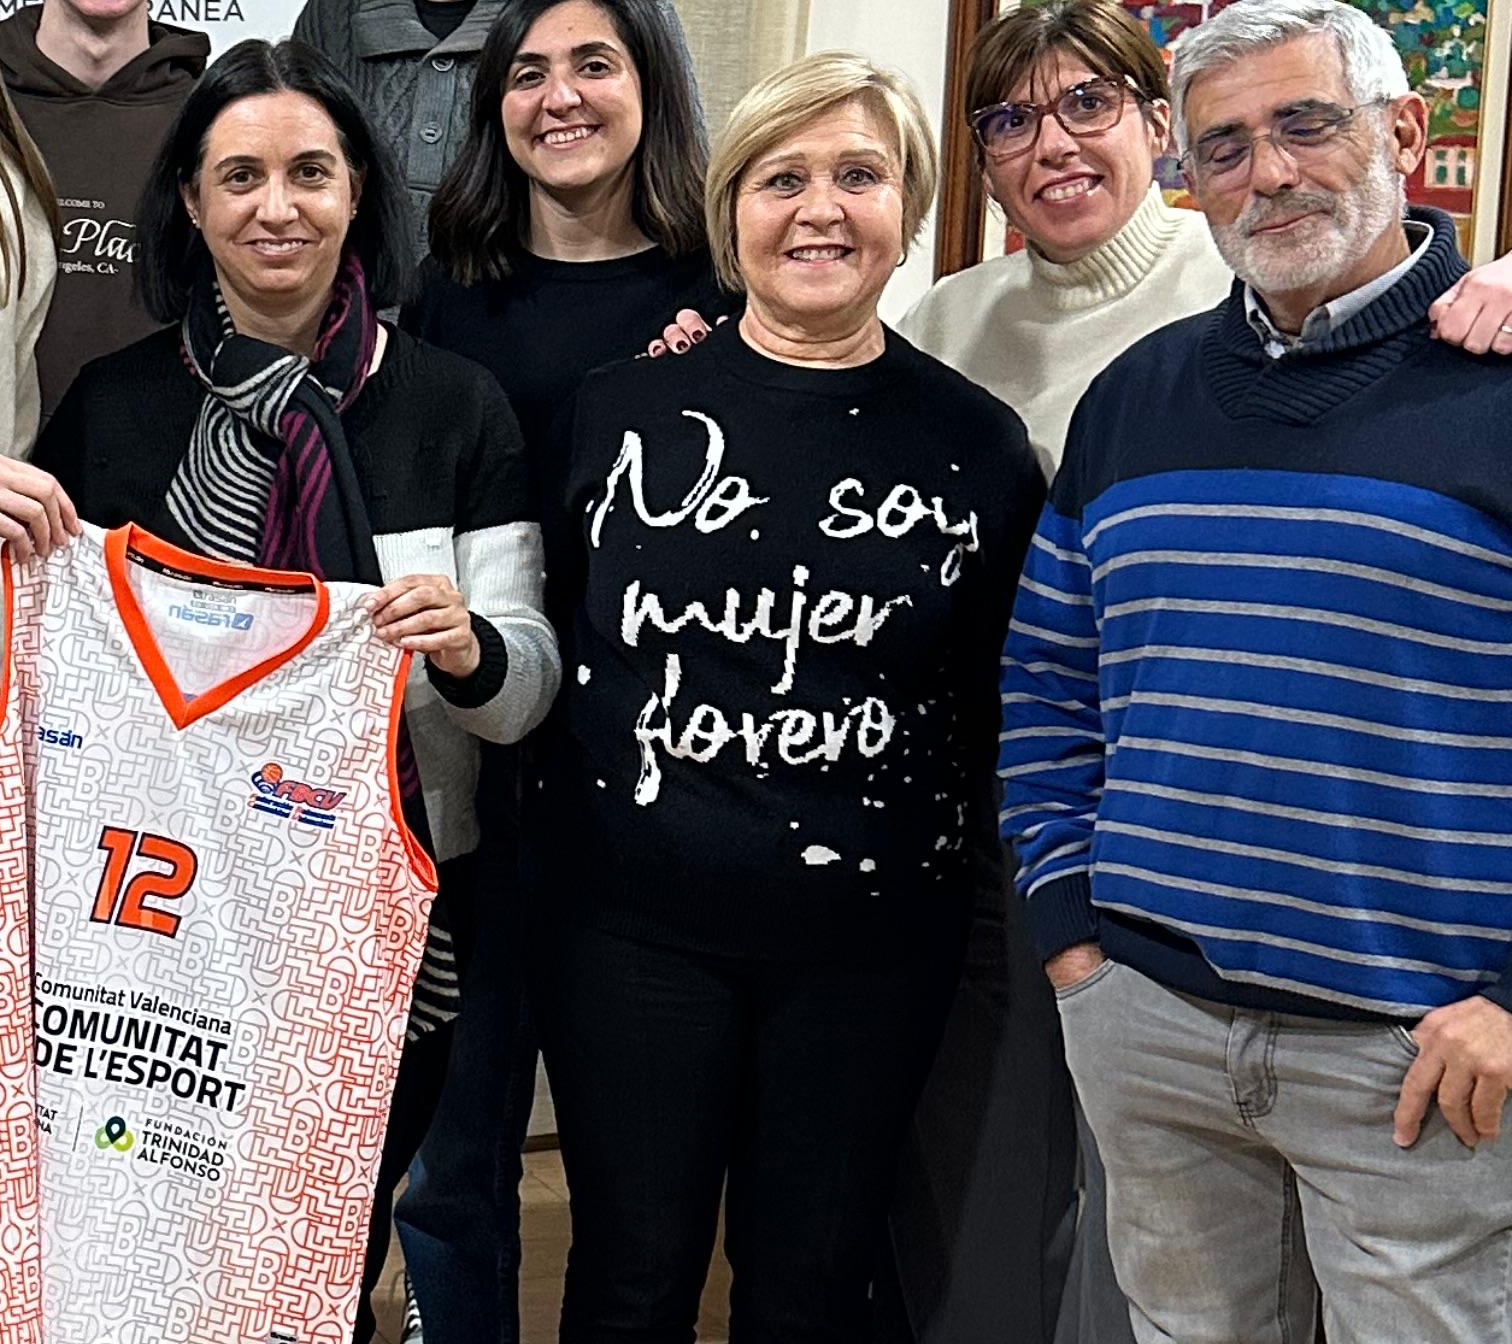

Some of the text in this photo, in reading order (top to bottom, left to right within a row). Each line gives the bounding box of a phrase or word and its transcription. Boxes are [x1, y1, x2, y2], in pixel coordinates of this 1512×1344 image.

[60, 218, 141, 263] Plac
[818, 478, 980, 587] soy
[621, 564, 914, 695] mujer
[38, 725, 84, 749] asán
[633, 653, 897, 807] florero
[89, 825, 198, 939] 12
[130, 990, 232, 1035] Valenciana
[35, 1035, 78, 1075] DE
[141, 1130, 225, 1167] TRINIDAD
[144, 1117, 228, 1151] FUNDACIÓN
[136, 1146, 221, 1182] ALFONSO
